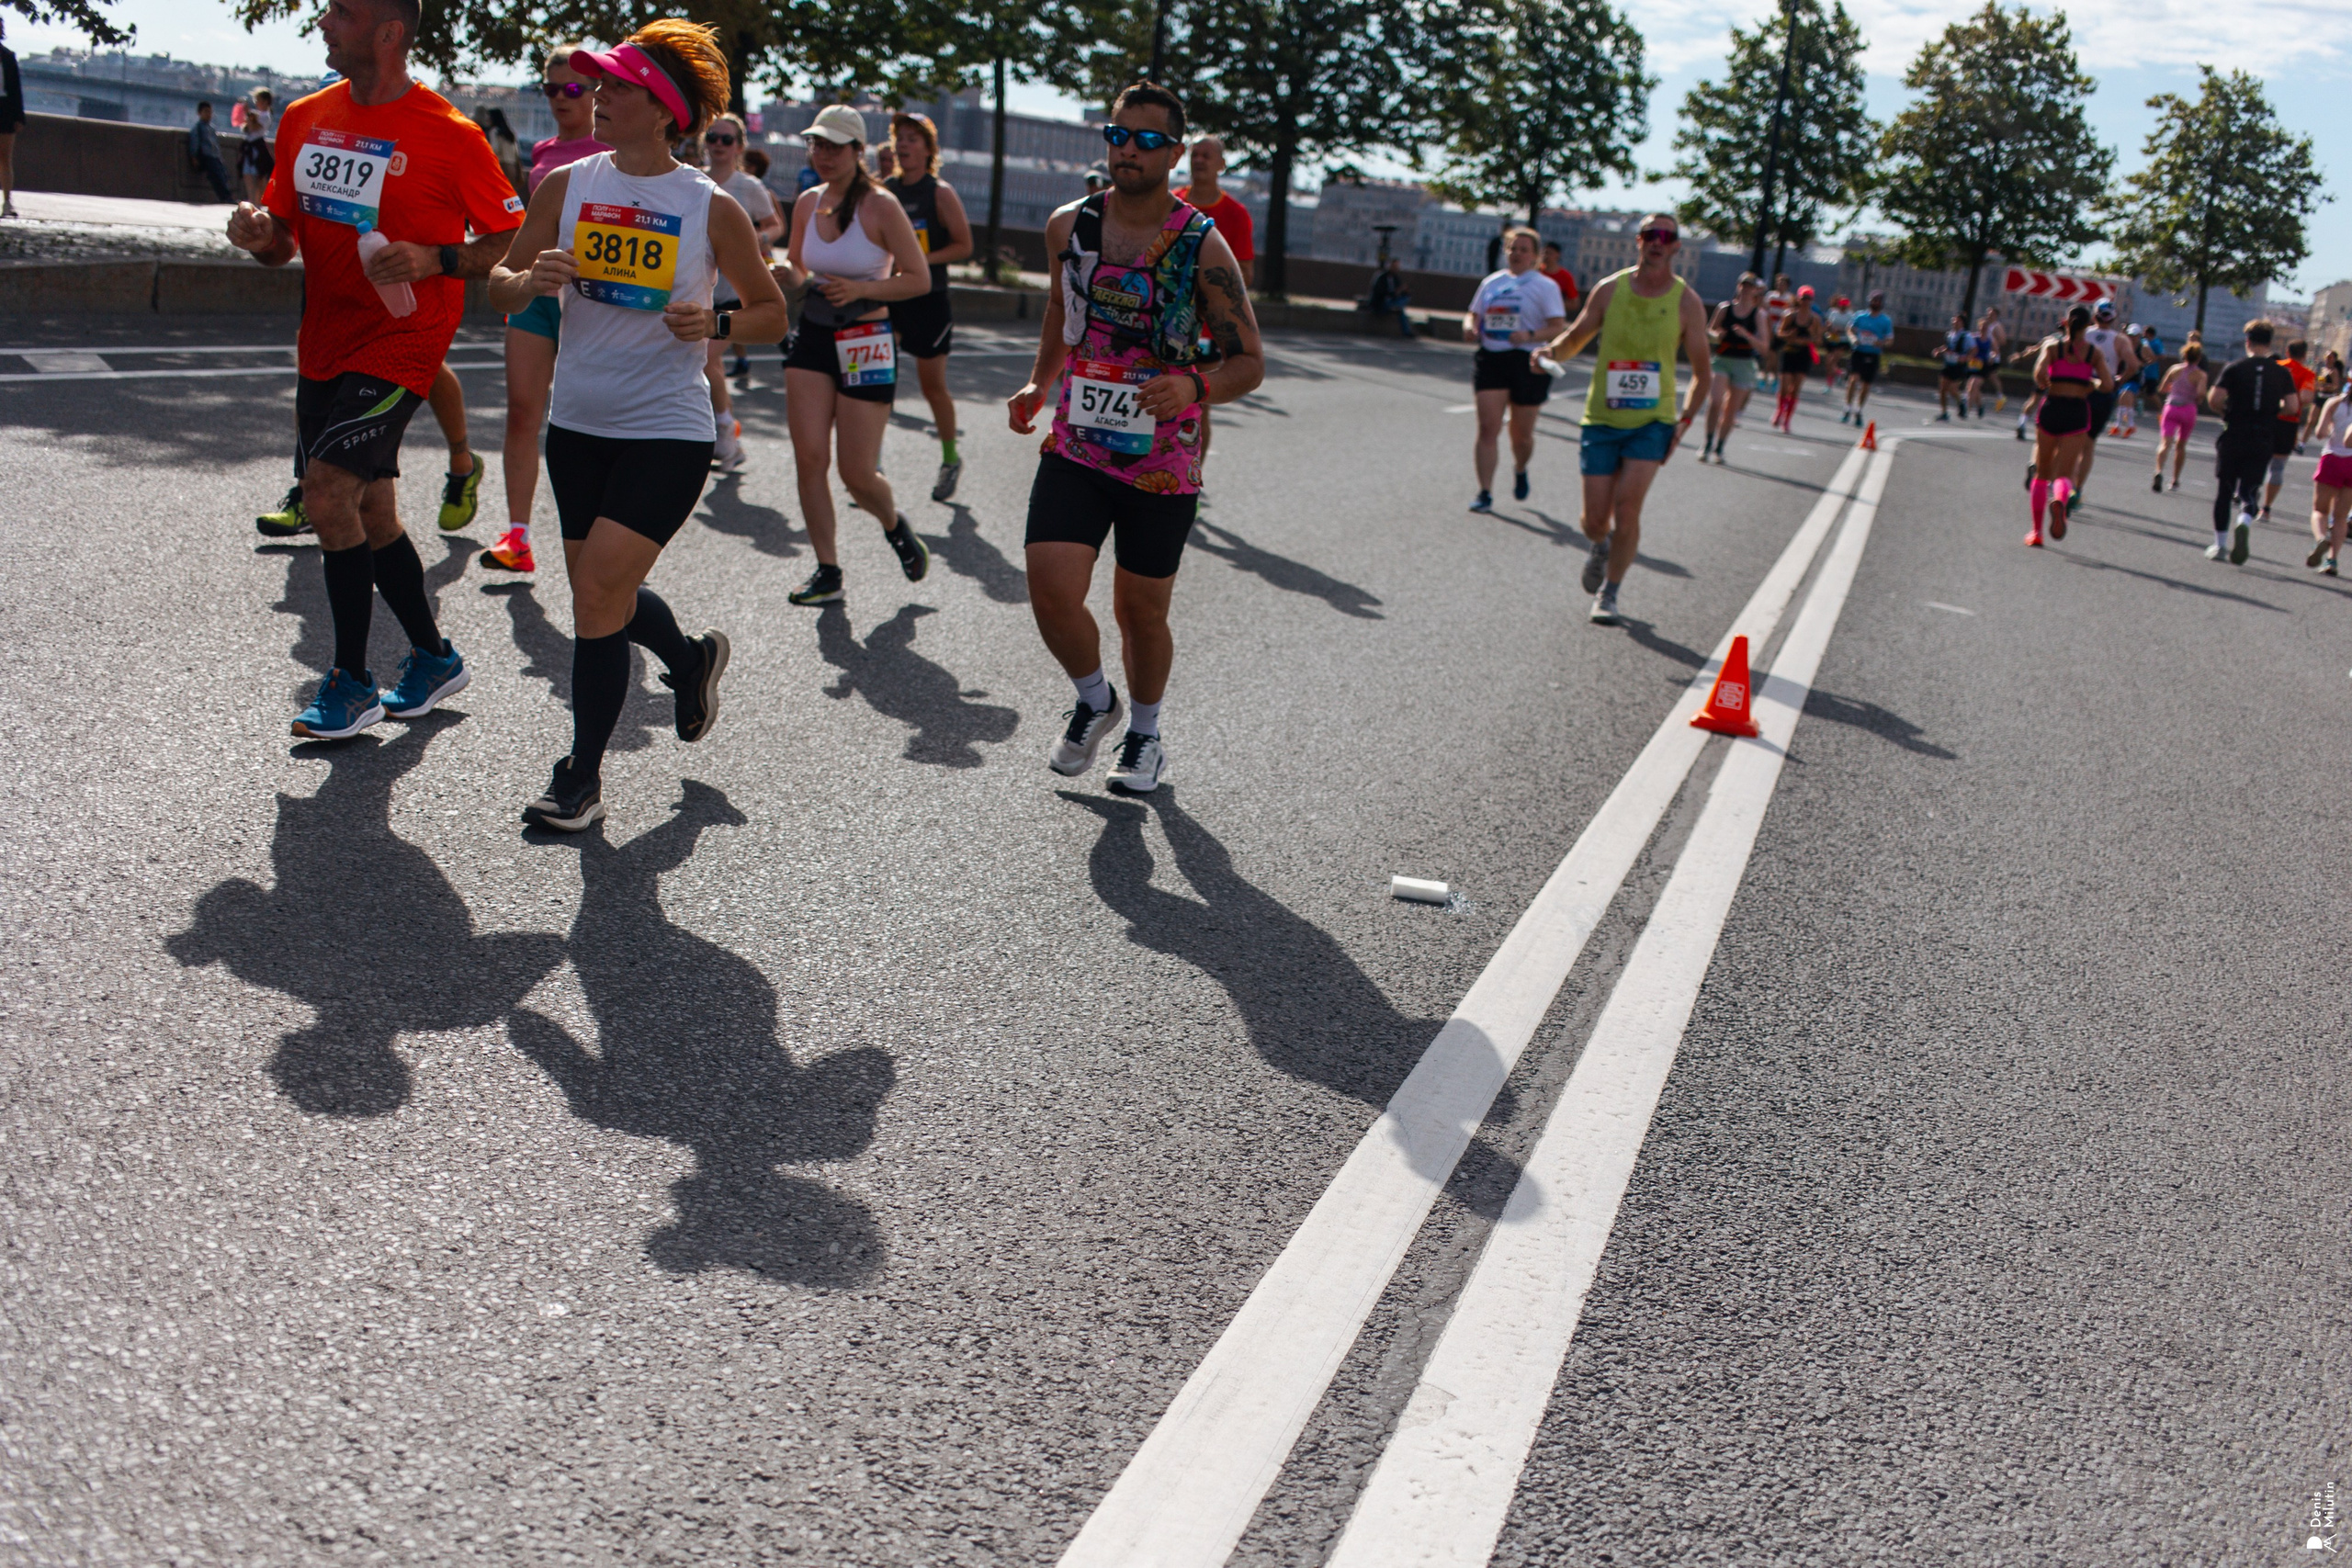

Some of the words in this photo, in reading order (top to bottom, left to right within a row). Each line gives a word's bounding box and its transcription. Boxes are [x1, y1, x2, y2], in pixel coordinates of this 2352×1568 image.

[355, 140, 368, 149] 21,1
[369, 143, 382, 152] КМ
[305, 152, 374, 188] 3819
[311, 182, 360, 198] АЛЕКСАНДР
[301, 196, 311, 211] E
[593, 205, 608, 213] ПОЛУ
[591, 211, 621, 220] МАРАФОН
[635, 214, 650, 224] 21,1
[652, 218, 667, 228] КМ
[584, 231, 663, 270] 3818
[603, 266, 637, 279] АЛИНА
[580, 280, 591, 297] E
[846, 343, 892, 365] 7743
[1123, 371, 1136, 380] 21,1
[1618, 373, 1649, 390] 459
[1094, 416, 1128, 427] АГАСИФ
[343, 425, 387, 449] SPORT
[1076, 427, 1087, 441] E
